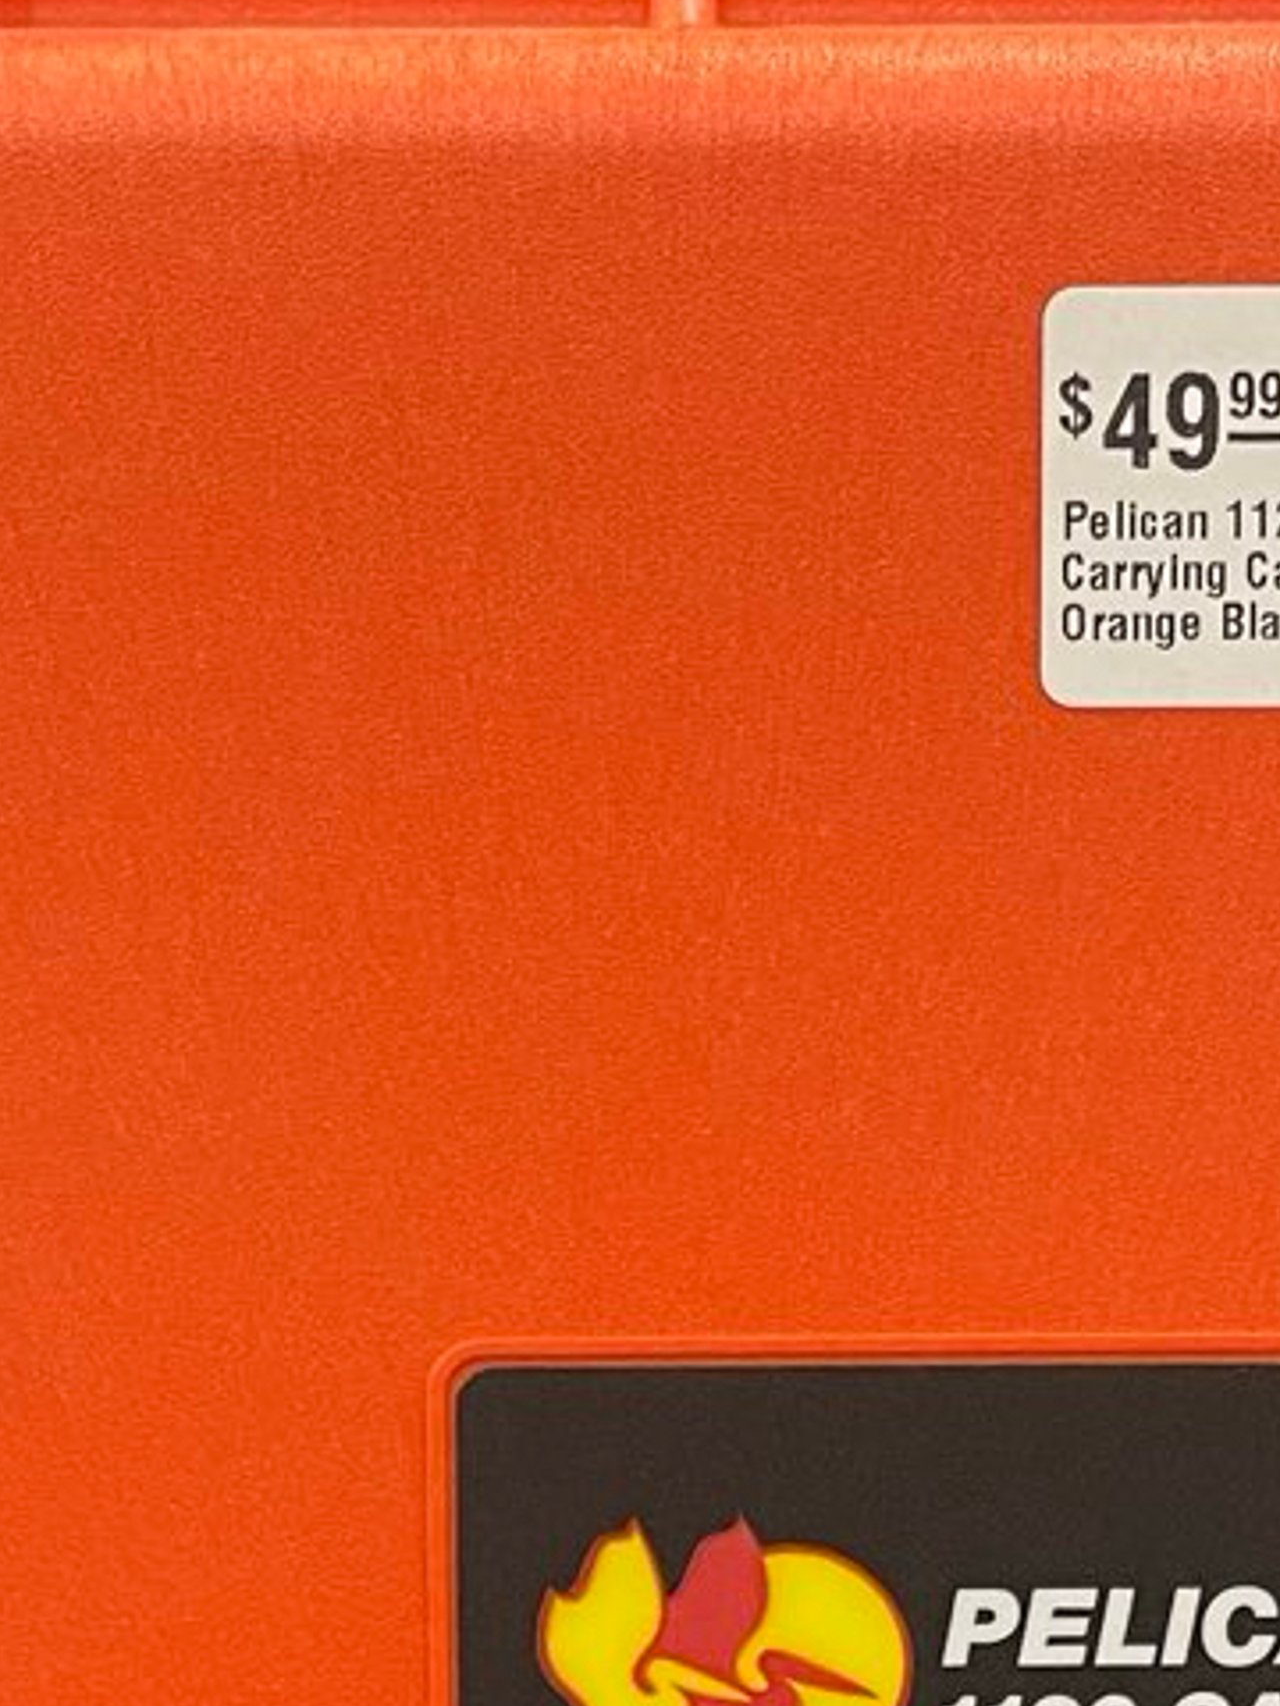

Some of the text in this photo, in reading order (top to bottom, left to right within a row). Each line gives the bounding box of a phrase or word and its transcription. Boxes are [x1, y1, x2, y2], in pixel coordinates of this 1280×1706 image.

[1063, 500, 1209, 541] Pelican
[1061, 552, 1228, 599] Carrying
[1061, 604, 1201, 651] Orange
